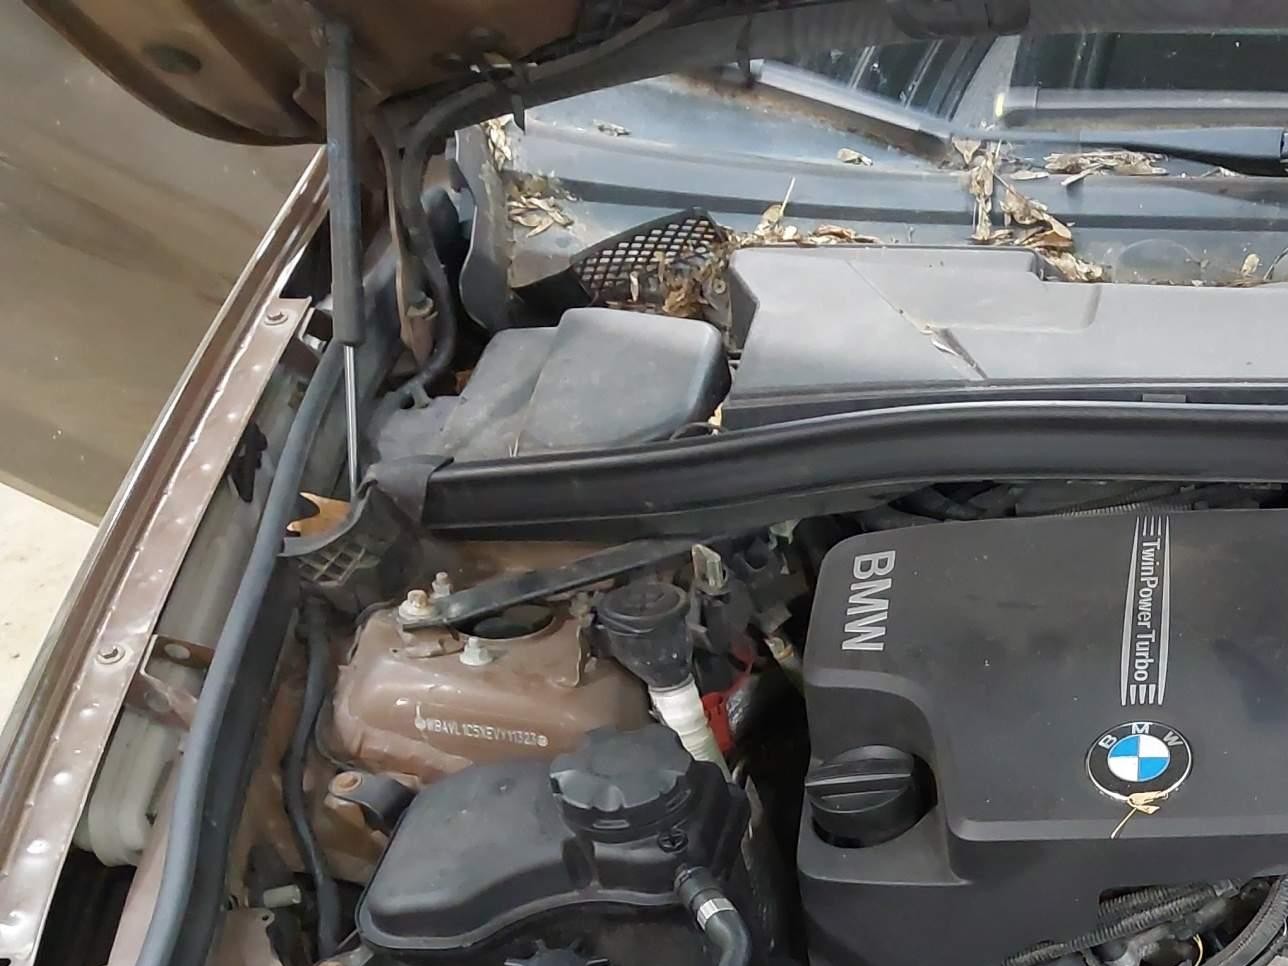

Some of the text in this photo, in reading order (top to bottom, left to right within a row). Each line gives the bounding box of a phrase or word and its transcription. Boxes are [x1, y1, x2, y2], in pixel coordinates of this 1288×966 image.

[842, 549, 896, 651] BMW
[1134, 538, 1161, 682] TwinPower Turbo
[1098, 722, 1184, 750] BMW
